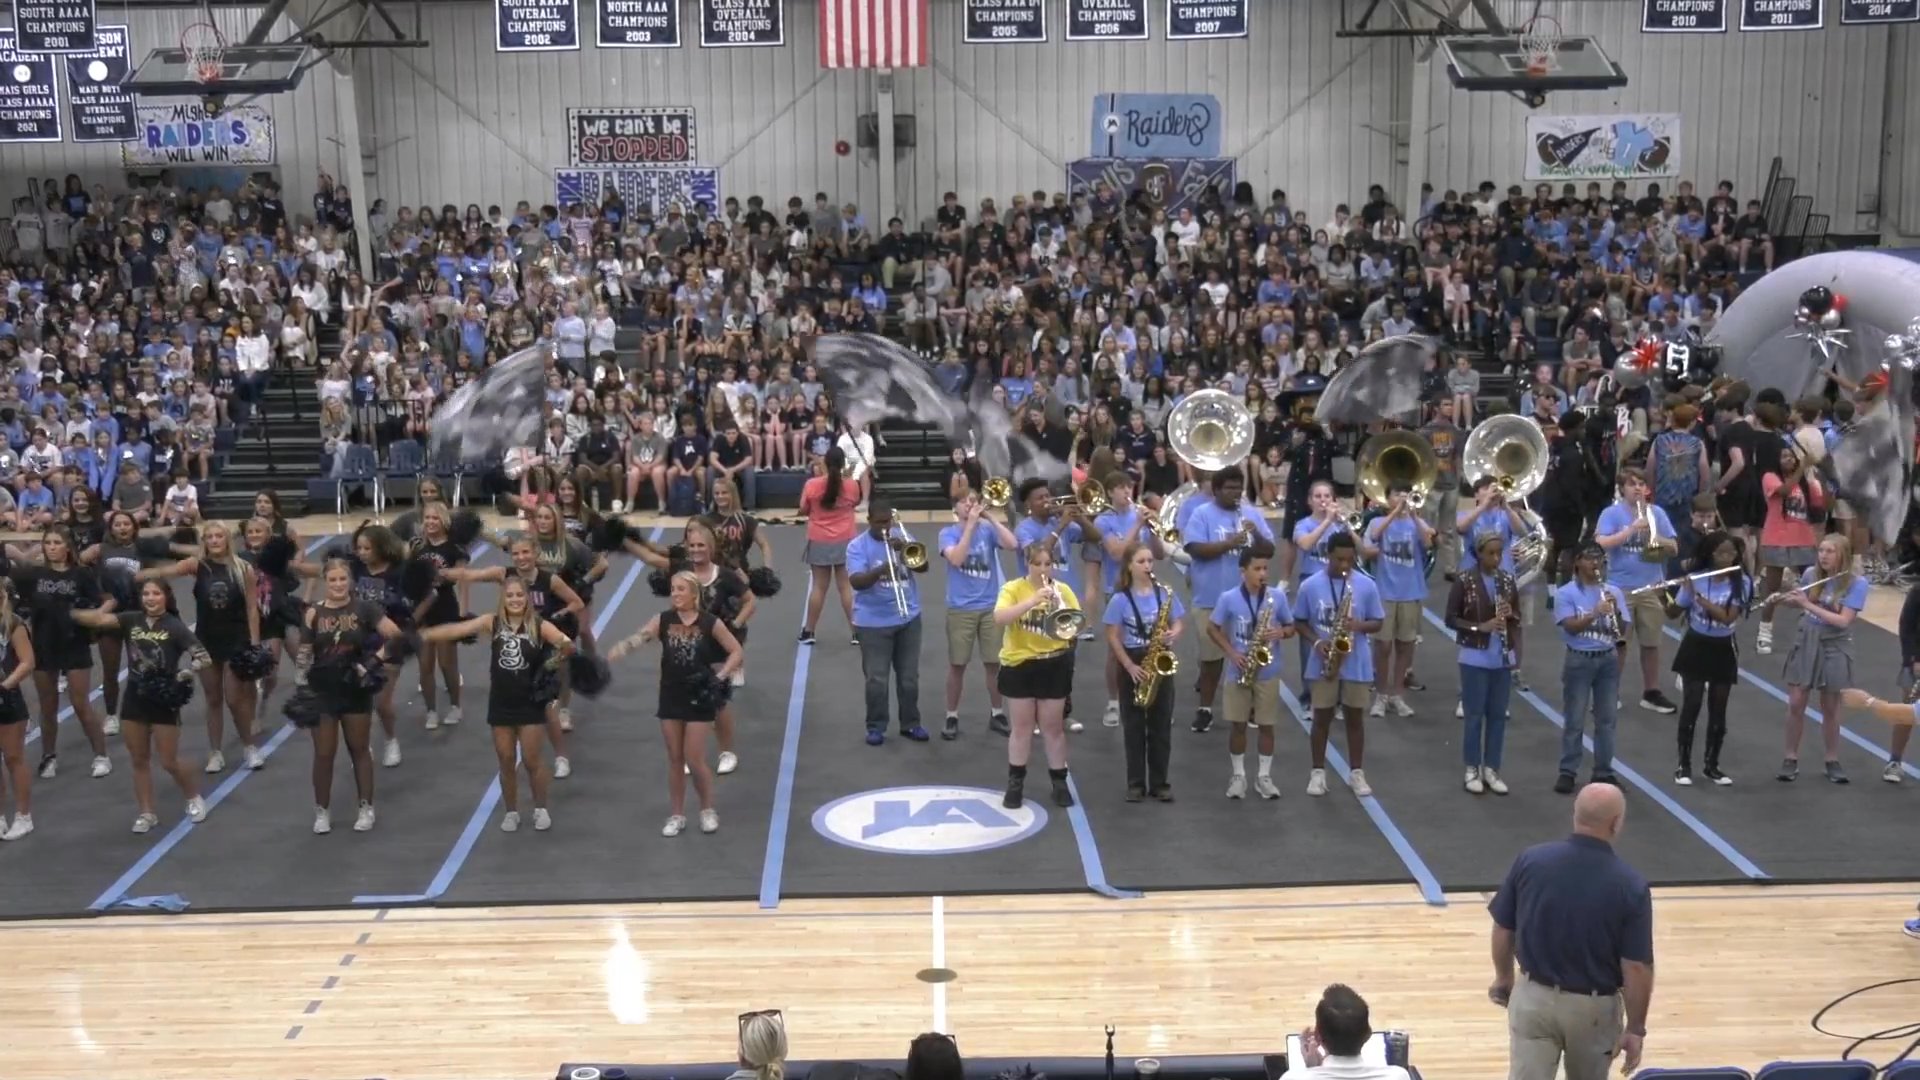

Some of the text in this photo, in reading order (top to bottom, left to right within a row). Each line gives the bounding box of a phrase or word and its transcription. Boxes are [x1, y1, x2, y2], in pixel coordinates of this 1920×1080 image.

[607, 1, 668, 13] NORTH AAA
[711, 0, 771, 8] CLASS AAA
[1082, 0, 1131, 8] OVERALL
[1656, 0, 1715, 12] CHAMPIONS
[1754, 0, 1812, 12] CHAMPIONS
[1868, 4, 1891, 16] 2014
[20, 6, 90, 18] SOUTH AAAA
[512, 8, 560, 20] OVERALL
[716, 8, 766, 20] OVERALL
[975, 10, 1034, 22] CHAMPIONS
[1078, 10, 1136, 22] CHAMPIONS
[1178, 6, 1237, 19] CHAMPIONS
[608, 16, 668, 28] CHAMPIONS
[1671, 14, 1697, 26] 2010
[1770, 13, 1793, 24] 2011
[26, 22, 86, 34] CHAMPIONS
[507, 20, 566, 33] CHAMPIONS
[712, 19, 772, 32] CHAMPIONS
[992, 25, 1018, 37] 2005
[1094, 23, 1120, 34] 2006
[1194, 20, 1221, 33] 2007
[44, 36, 70, 48] 2001
[524, 34, 552, 46] 2002
[626, 30, 652, 42] 2003
[728, 31, 756, 42] 2004
[22, 84, 50, 94] GIRLS
[0, 98, 22, 108] LASS
[72, 96, 96, 104] CLASS
[1, 110, 52, 120] CHAMPIONS
[84, 106, 120, 114] OVERALL
[82, 116, 126, 124] CHAMPIONS
[615, 116, 654, 135] can't
[663, 116, 682, 134] be
[1124, 102, 1211, 148] Raiders
[17, 122, 38, 132] 2021
[147, 120, 247, 148] RAIDERS
[166, 145, 229, 162] WILL WIN
[581, 135, 688, 162] STOPPED
[862, 798, 1021, 840] JA
